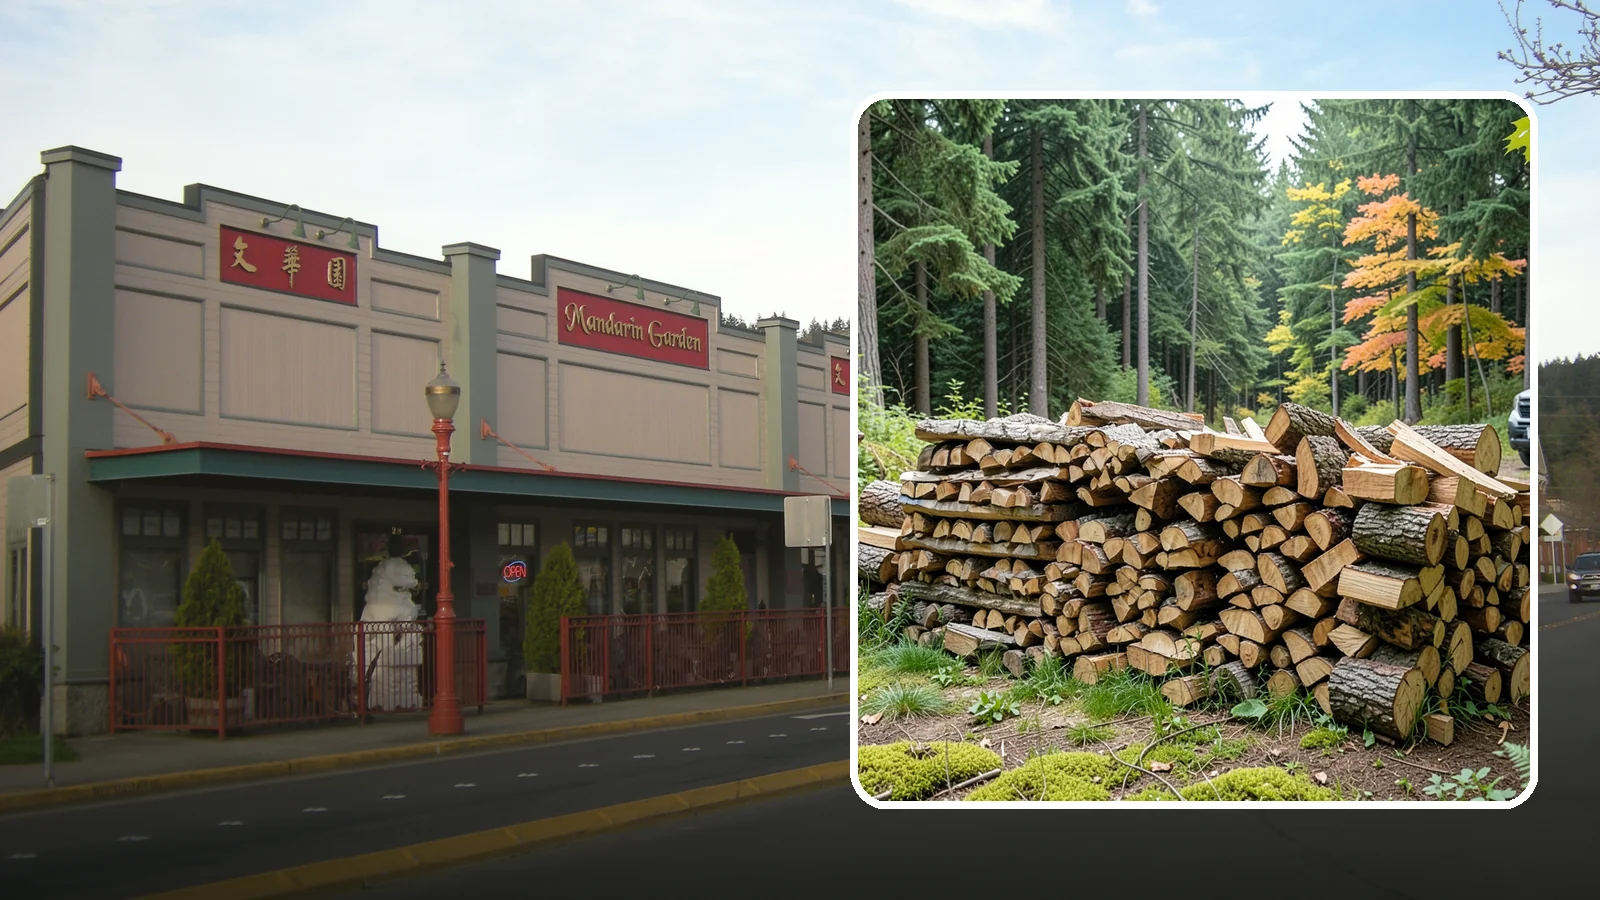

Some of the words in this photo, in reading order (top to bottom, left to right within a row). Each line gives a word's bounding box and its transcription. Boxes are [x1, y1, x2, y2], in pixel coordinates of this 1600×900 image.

[230, 235, 347, 291] 文華園
[564, 302, 644, 341] Mandarin
[648, 320, 701, 352] Garden
[503, 565, 527, 578] OPEN
